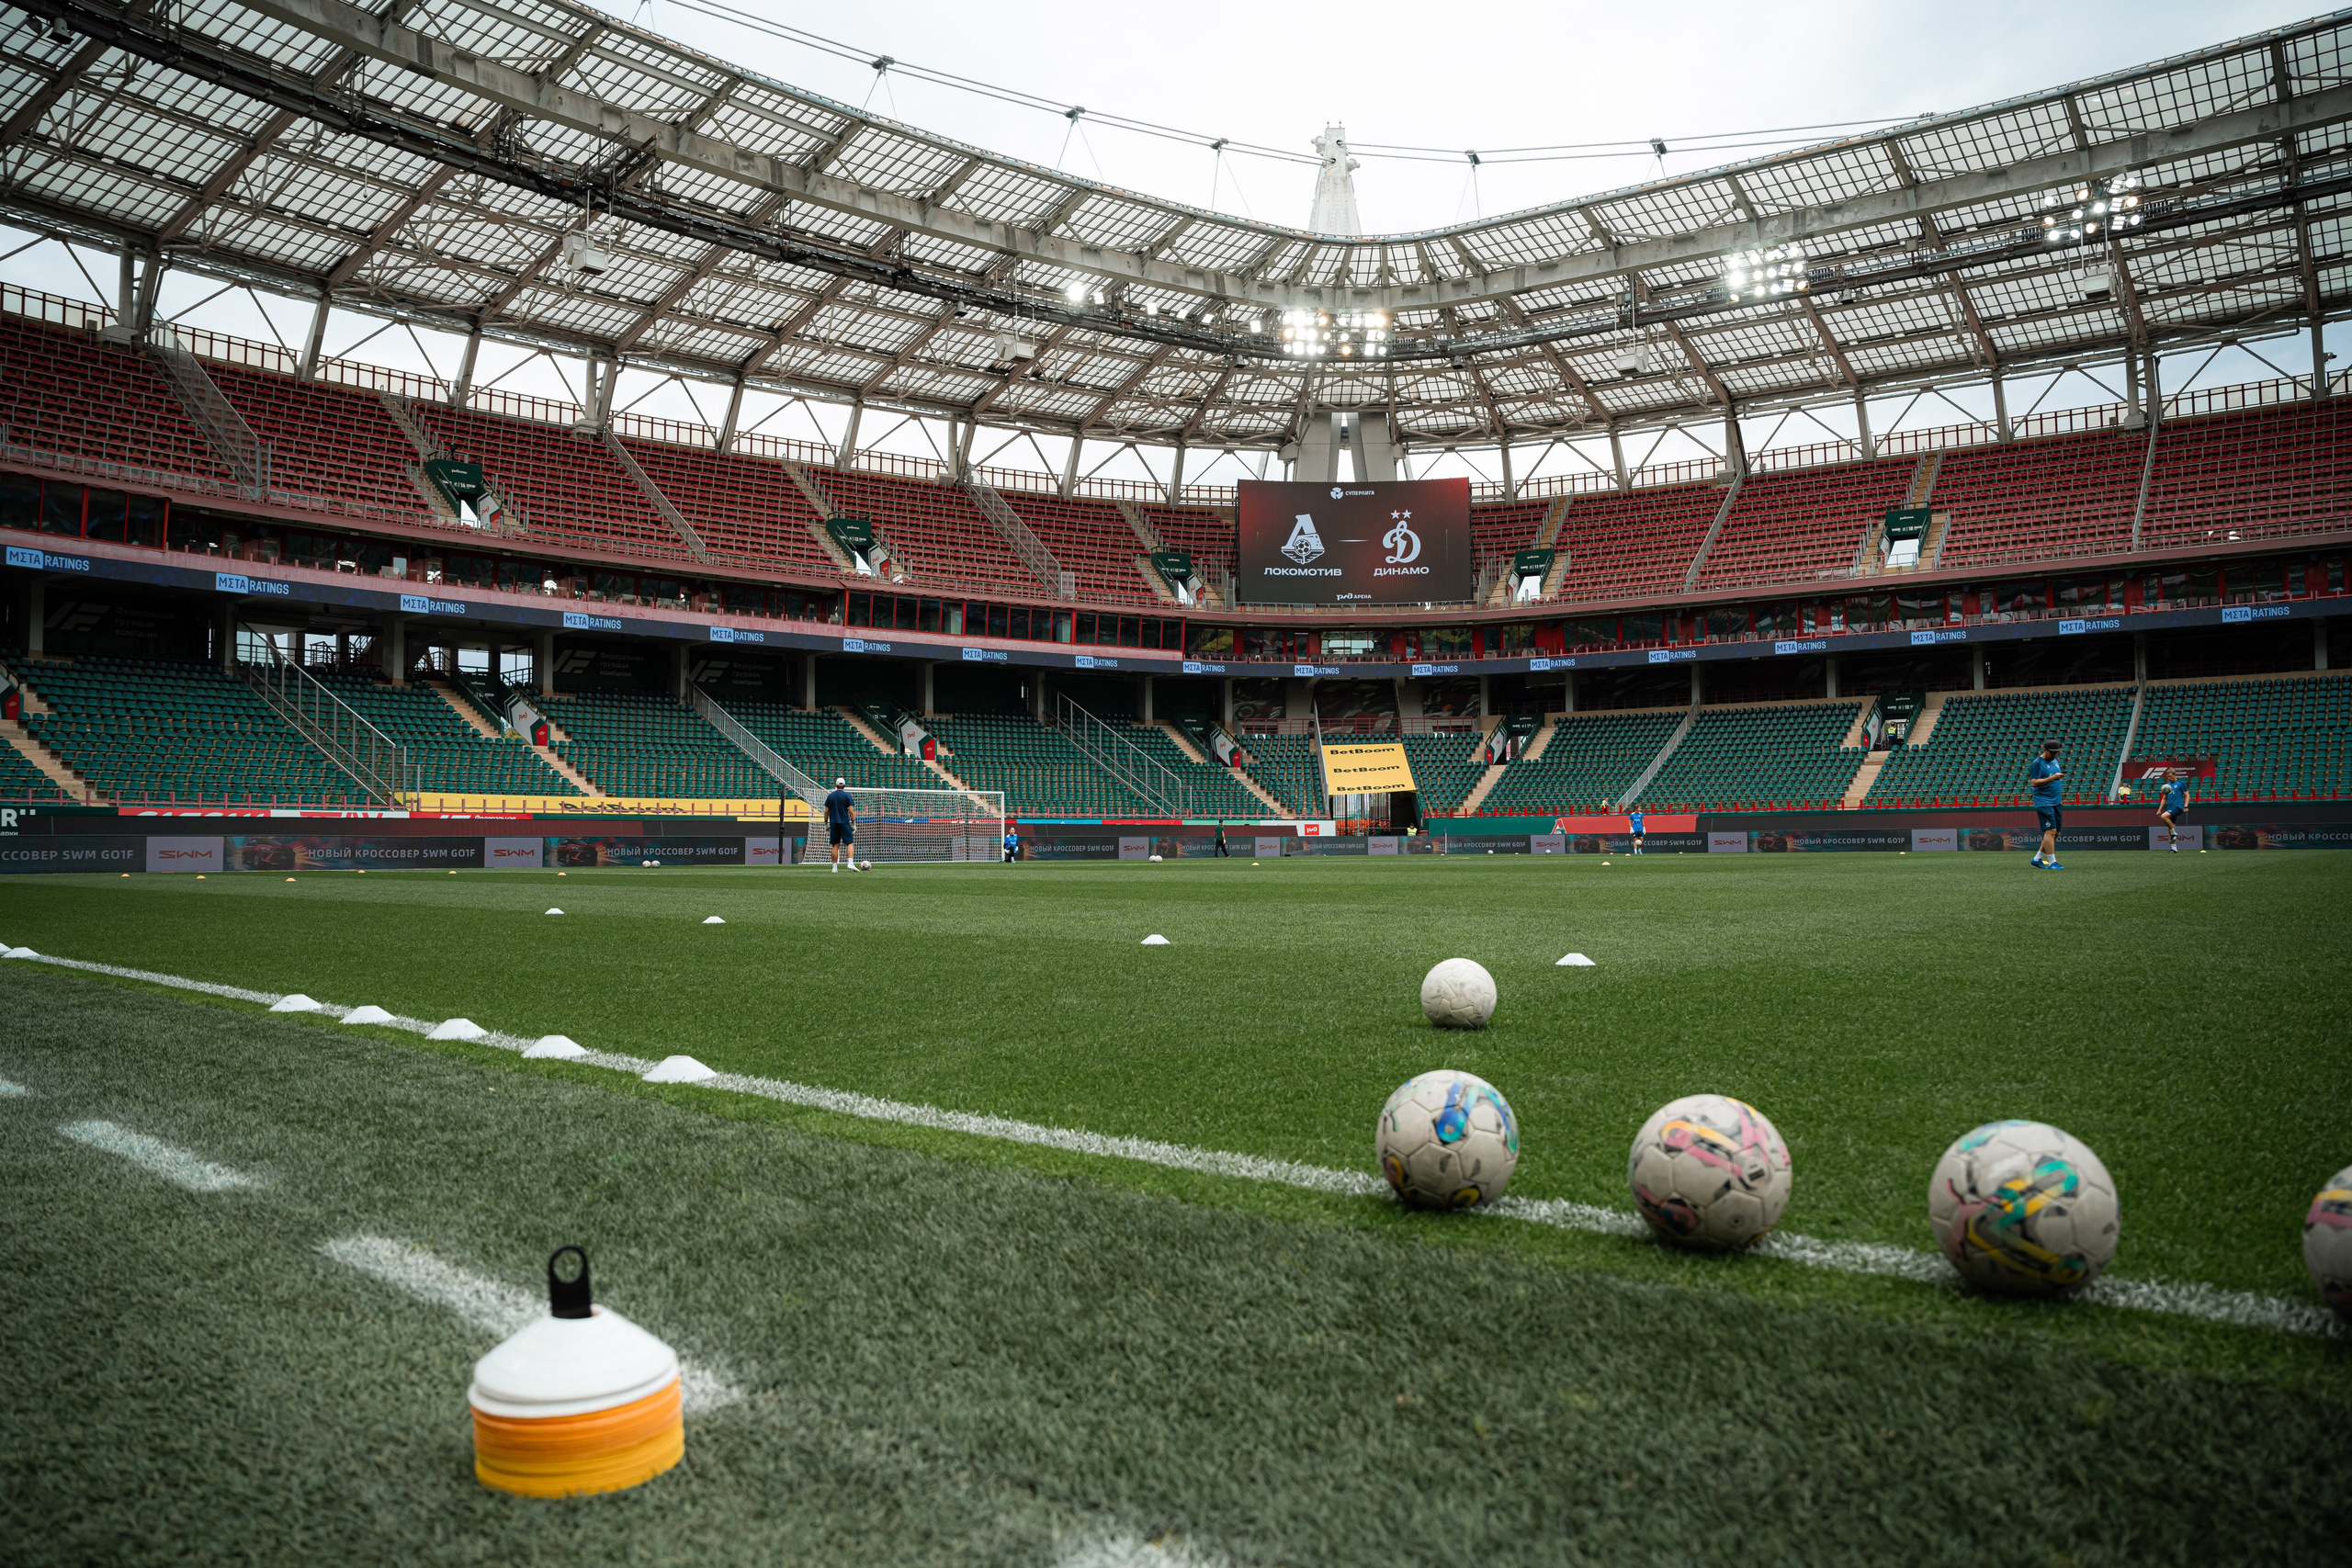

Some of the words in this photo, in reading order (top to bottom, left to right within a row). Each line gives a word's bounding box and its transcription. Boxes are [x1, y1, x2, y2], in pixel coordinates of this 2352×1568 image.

[45, 555, 90, 571] RATINGS
[1263, 567, 1342, 577] ЛОКОМОТИВ
[1374, 566, 1430, 577] ДИНАМО
[249, 580, 289, 595] RATINGS
[429, 600, 466, 614] RATINGS
[2252, 606, 2290, 618] RATINGS
[589, 617, 622, 629] RATINGS
[2086, 619, 2120, 629] RATINGS
[734, 631, 764, 642] RATINGS
[1936, 631, 1966, 641] RATINGS
[864, 642, 891, 652] RATINGS
[1797, 641, 1826, 650] RATINGS
[600, 651, 644, 662] Федеральная
[982, 651, 1008, 660] RATINGS
[1669, 650, 1696, 660] RATINGS
[600, 661, 629, 671] грузовая
[1093, 659, 1118, 668] RATINGS
[1202, 664, 1226, 672] RATINGS
[1550, 659, 1576, 668] RATINGS
[1314, 667, 1340, 675] RATINGS
[1432, 665, 1458, 673] RATINGS
[600, 670, 632, 678] компания
[1330, 747, 1396, 755] BetBoom
[1333, 764, 1400, 773] BetBoom
[1337, 783, 1405, 792] BetBoom
[1794, 836, 1820, 844] НОВЫЙ
[2012, 834, 2042, 842] НОВЫЙ
[2268, 832, 2305, 840] НОВЫЙ
[1030, 843, 1051, 852] НОВЫЙ
[1606, 839, 1629, 847] НОВЫЙ
[62, 850, 96, 860] SWM
[159, 850, 212, 859] SWM
[308, 847, 352, 858] НОВЫЙ
[355, 849, 420, 858] КРОССОВЕР
[423, 849, 447, 858] SWM
[493, 849, 535, 857] SWM
[607, 845, 641, 856] НОВЫЙ
[643, 847, 695, 856] КРОССОВЕР
[696, 847, 717, 855] SWM
